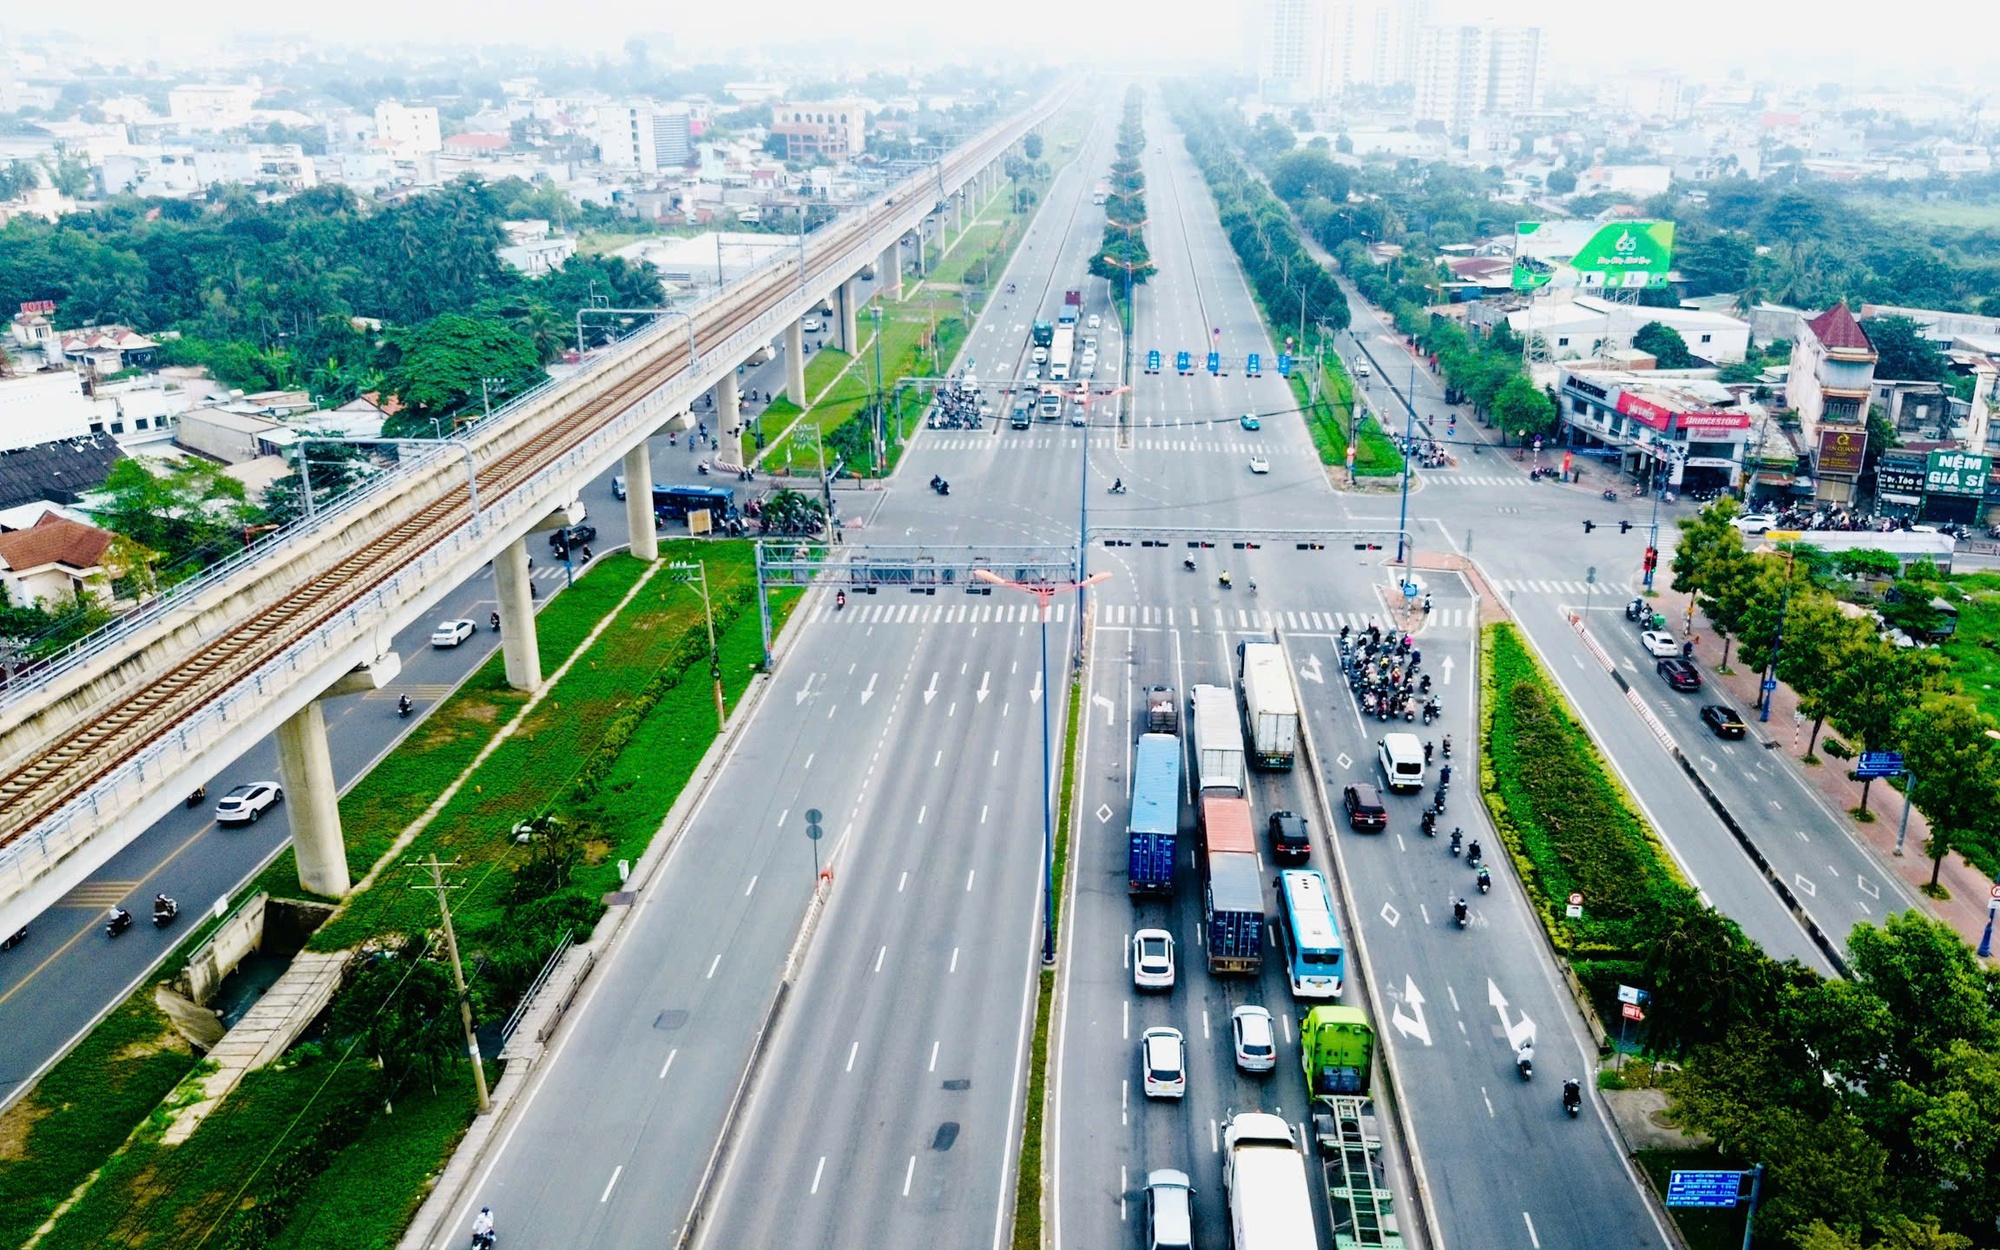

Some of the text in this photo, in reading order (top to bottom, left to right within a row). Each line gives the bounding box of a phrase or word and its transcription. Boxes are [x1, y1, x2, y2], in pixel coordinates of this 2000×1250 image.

[1685, 416, 1741, 426] BRIDGESTONE
[1938, 454, 1982, 471] NỆM
[1928, 471, 1959, 485] GIÁ
